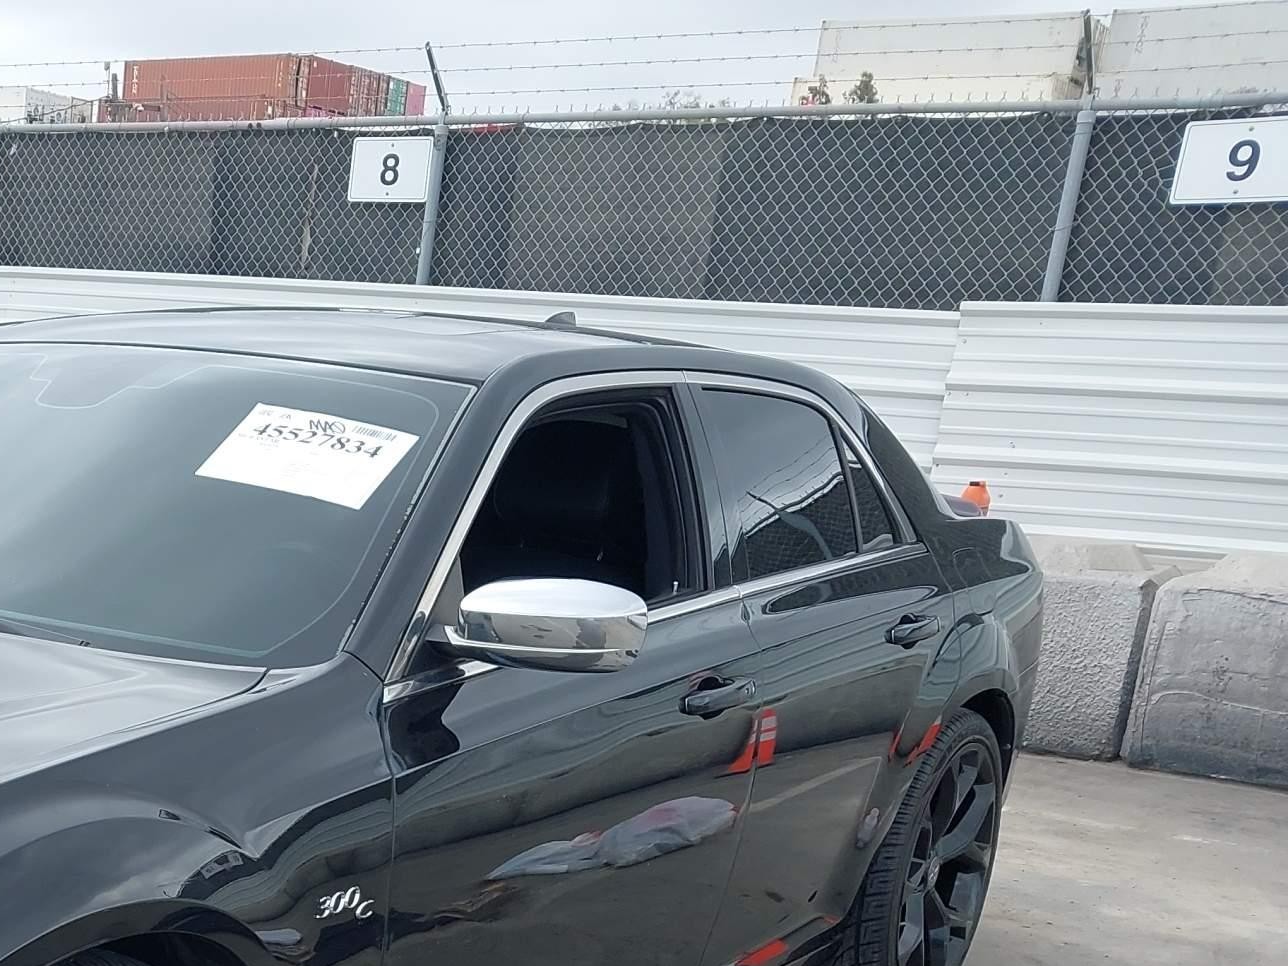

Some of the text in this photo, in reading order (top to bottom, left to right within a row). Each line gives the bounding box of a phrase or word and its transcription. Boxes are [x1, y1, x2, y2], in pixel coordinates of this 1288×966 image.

[380, 153, 400, 186] 8
[1226, 139, 1261, 182] 9
[252, 423, 383, 459] 45527834
[313, 885, 375, 919] 300C
